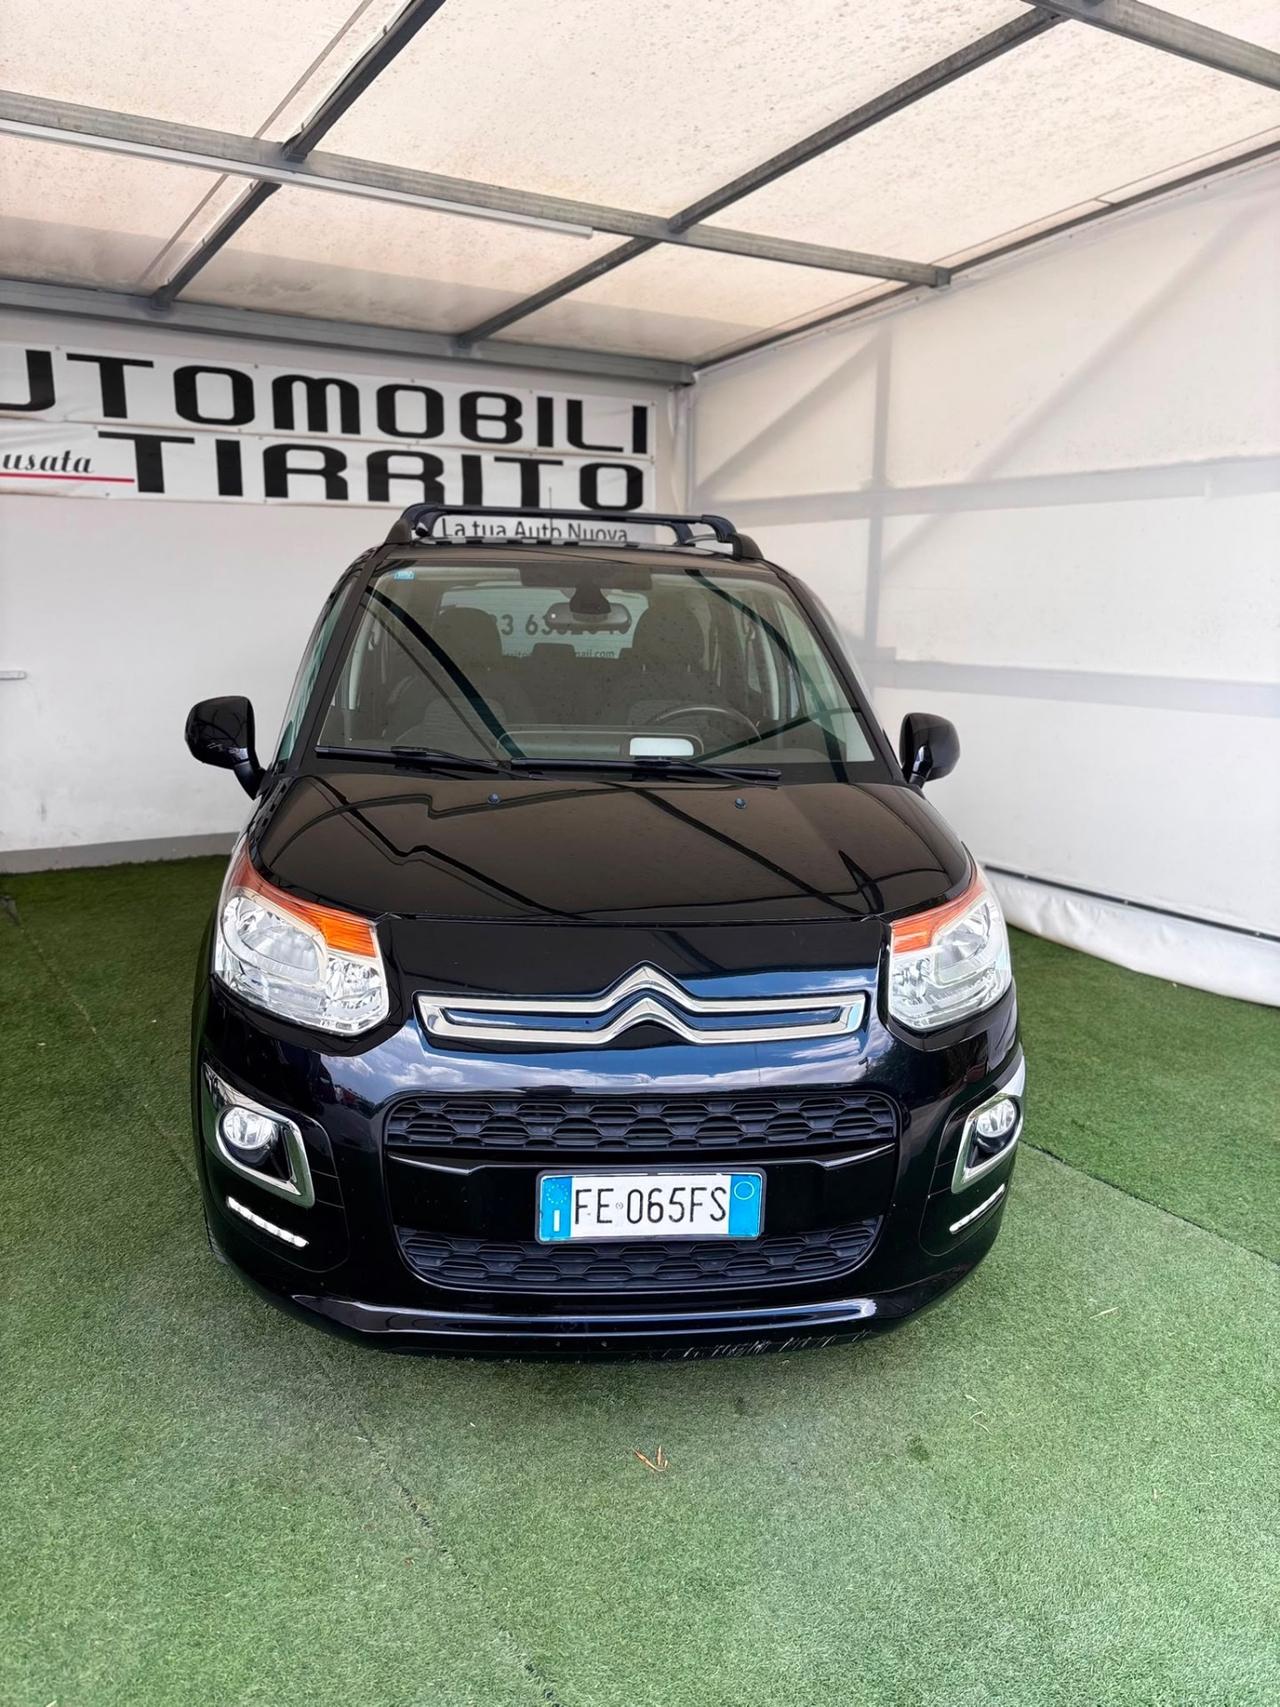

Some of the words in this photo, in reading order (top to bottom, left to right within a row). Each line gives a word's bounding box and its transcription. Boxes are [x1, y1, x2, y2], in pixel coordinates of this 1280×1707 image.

[2, 450, 95, 473] usata
[98, 431, 644, 511] TIRRITO
[441, 518, 466, 537] La
[472, 521, 507, 538] tua
[514, 520, 562, 540] Auto
[567, 522, 628, 542] Nuova
